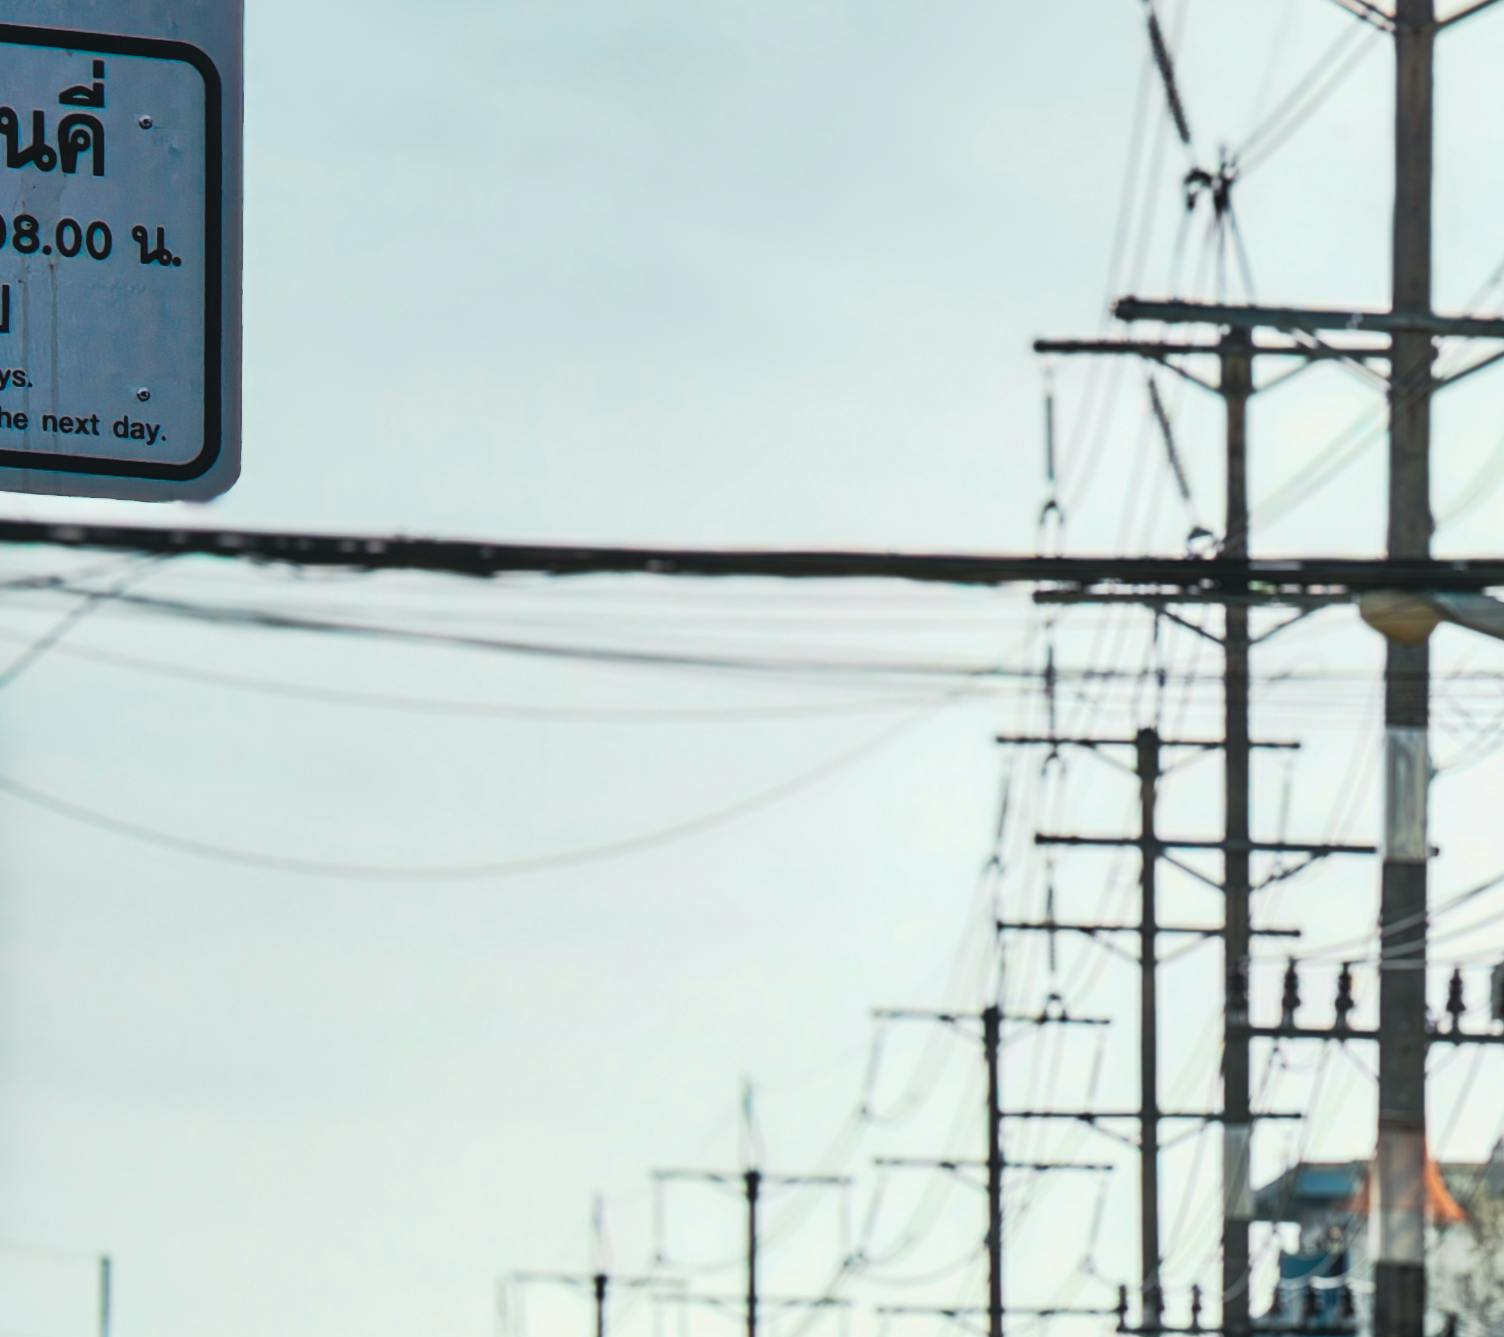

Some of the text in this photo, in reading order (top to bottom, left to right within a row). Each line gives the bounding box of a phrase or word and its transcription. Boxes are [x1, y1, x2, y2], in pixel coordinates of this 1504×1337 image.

[0, 213, 112, 260] 8.00
[42, 413, 100, 436] next
[113, 415, 167, 445] day.
